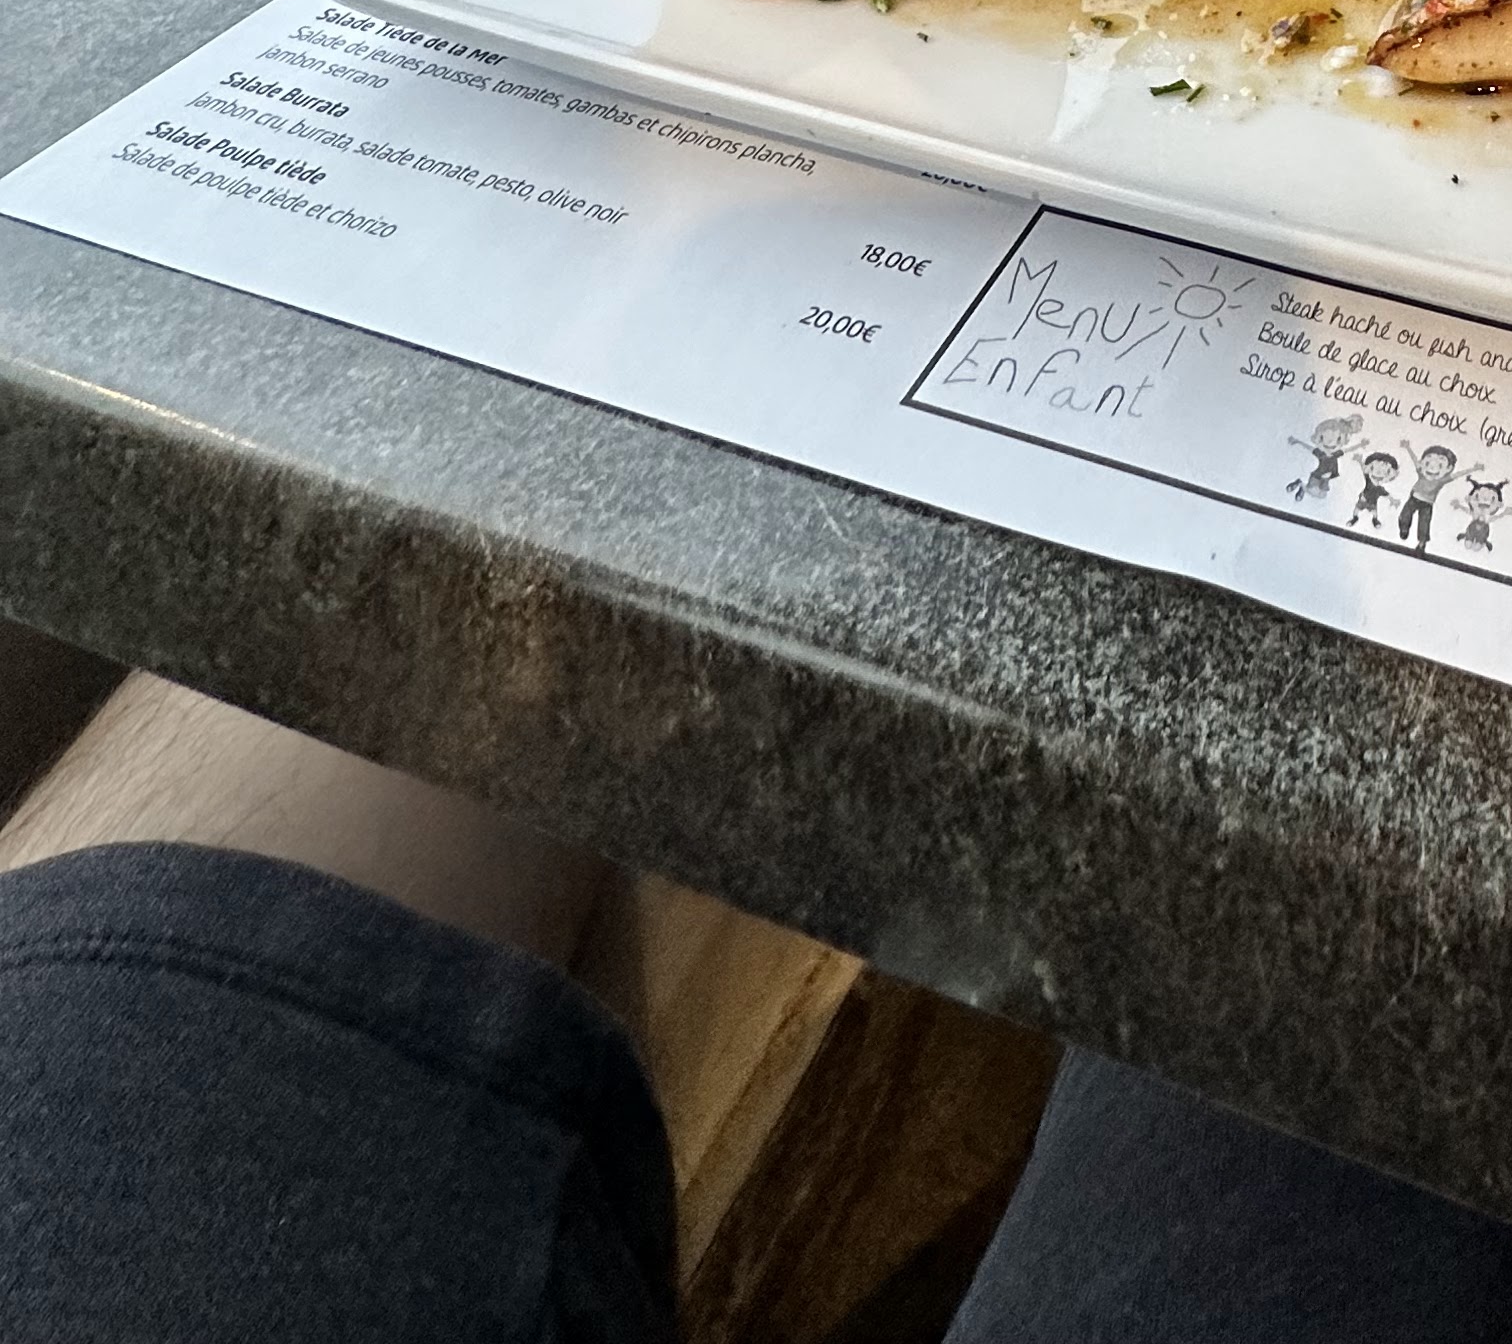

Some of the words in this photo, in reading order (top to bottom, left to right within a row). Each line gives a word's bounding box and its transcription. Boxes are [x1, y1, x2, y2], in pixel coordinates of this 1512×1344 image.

[316, 7, 374, 32] Salade
[377, 21, 424, 45] Tiède
[423, 34, 449, 51] de
[447, 43, 468, 57] la
[219, 71, 283, 99] Salade
[279, 87, 351, 118] Burrata
[288, 25, 346, 51] Salade
[344, 39, 369, 57] de
[363, 45, 426, 72] jeunes
[417, 63, 491, 91] pousses,
[492, 78, 562, 109] tomates,
[562, 95, 638, 127] gambas
[635, 115, 658, 132] et
[657, 118, 743, 156] chipirons
[737, 142, 817, 177] plancha,
[322, 60, 390, 90] serrano
[111, 142, 177, 172] Salade
[171, 160, 201, 181] de
[190, 168, 263, 200] poulpe
[258, 186, 309, 214] tiède
[304, 201, 330, 221] et
[326, 208, 398, 240] chorizo
[145, 120, 212, 150] Salade
[209, 138, 278, 170] Poulpe
[273, 157, 328, 186] tiède
[286, 118, 353, 152] burrata,
[352, 138, 415, 168] salade
[411, 153, 477, 186] tomate,
[477, 170, 535, 202] pesto,
[537, 187, 587, 214] olive
[582, 201, 630, 225] noir
[860, 243, 932, 277] 18,00€
[799, 306, 882, 343] 20,00€
[1009, 257, 1141, 344] Menu
[1270, 291, 1324, 323] Steak
[1329, 305, 1393, 340] haché
[1397, 328, 1424, 349] ou
[1426, 336, 1473, 363] fish
[943, 336, 1156, 419] Enfant
[1240, 353, 1296, 390] Sirop
[1302, 372, 1318, 394] à
[1375, 395, 1403, 416] au
[1409, 400, 1468, 435] choix
[1257, 321, 1311, 356] Boule
[1317, 341, 1342, 363] de
[1348, 348, 1400, 378] glace
[1405, 367, 1432, 387] au
[1439, 372, 1497, 405] choix
